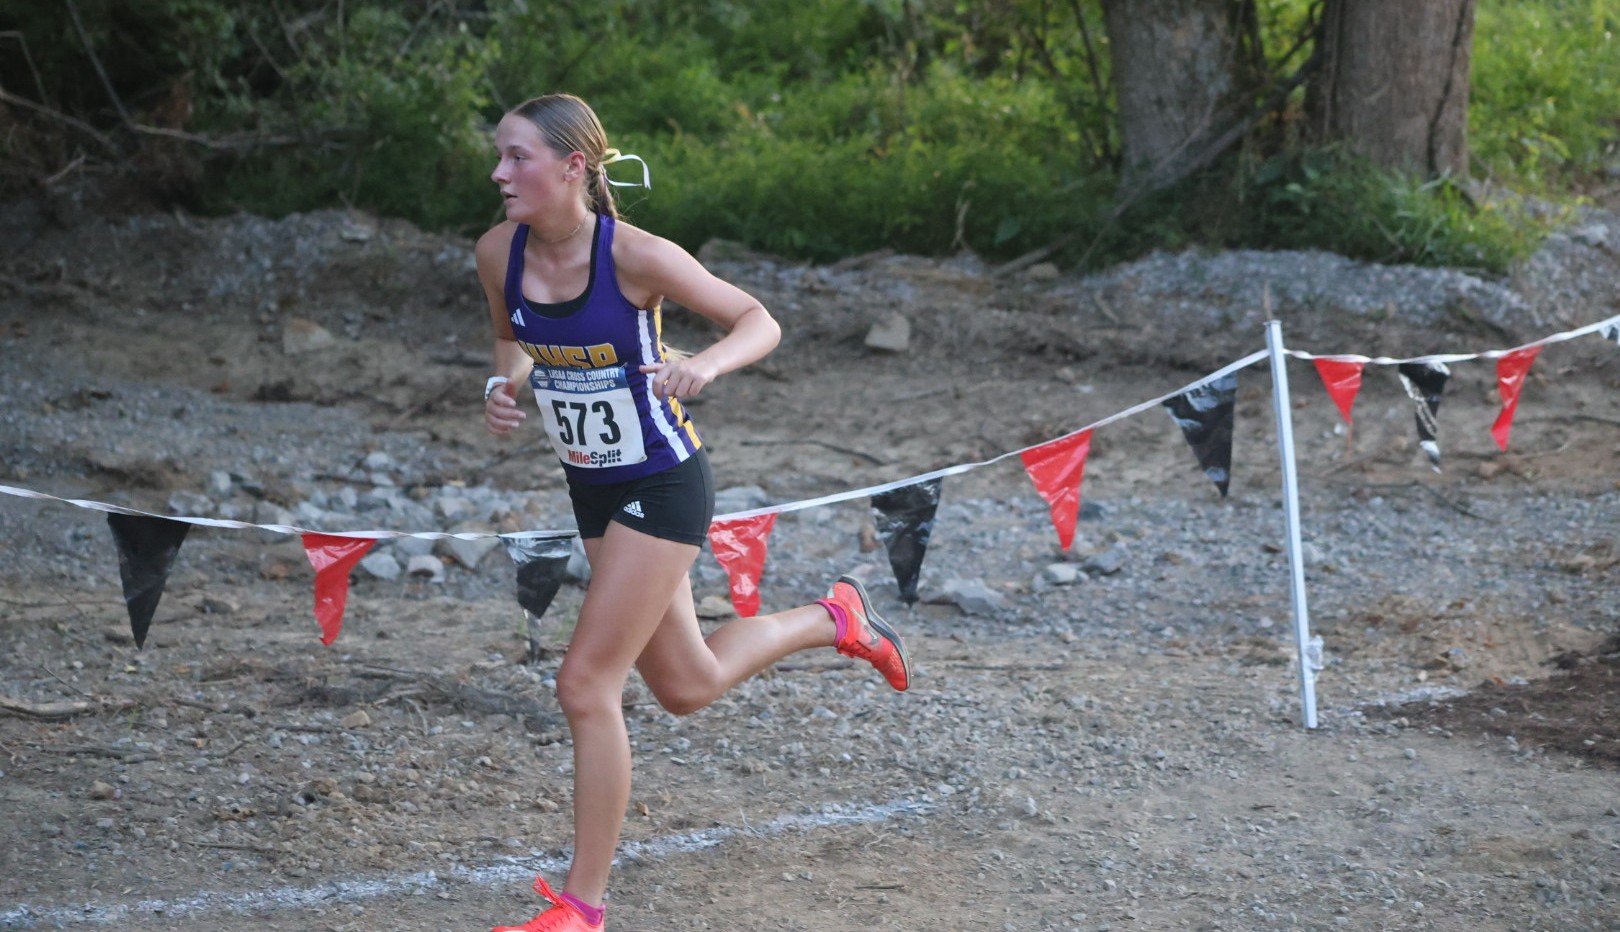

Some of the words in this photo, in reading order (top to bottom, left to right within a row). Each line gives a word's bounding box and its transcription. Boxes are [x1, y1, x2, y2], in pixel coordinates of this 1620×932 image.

[566, 370, 586, 382] CROSS
[586, 368, 619, 381] COUNTRY
[554, 379, 616, 392] CHAMPIONSHIPS
[551, 400, 622, 446] 573
[568, 449, 622, 467] MileSplit
